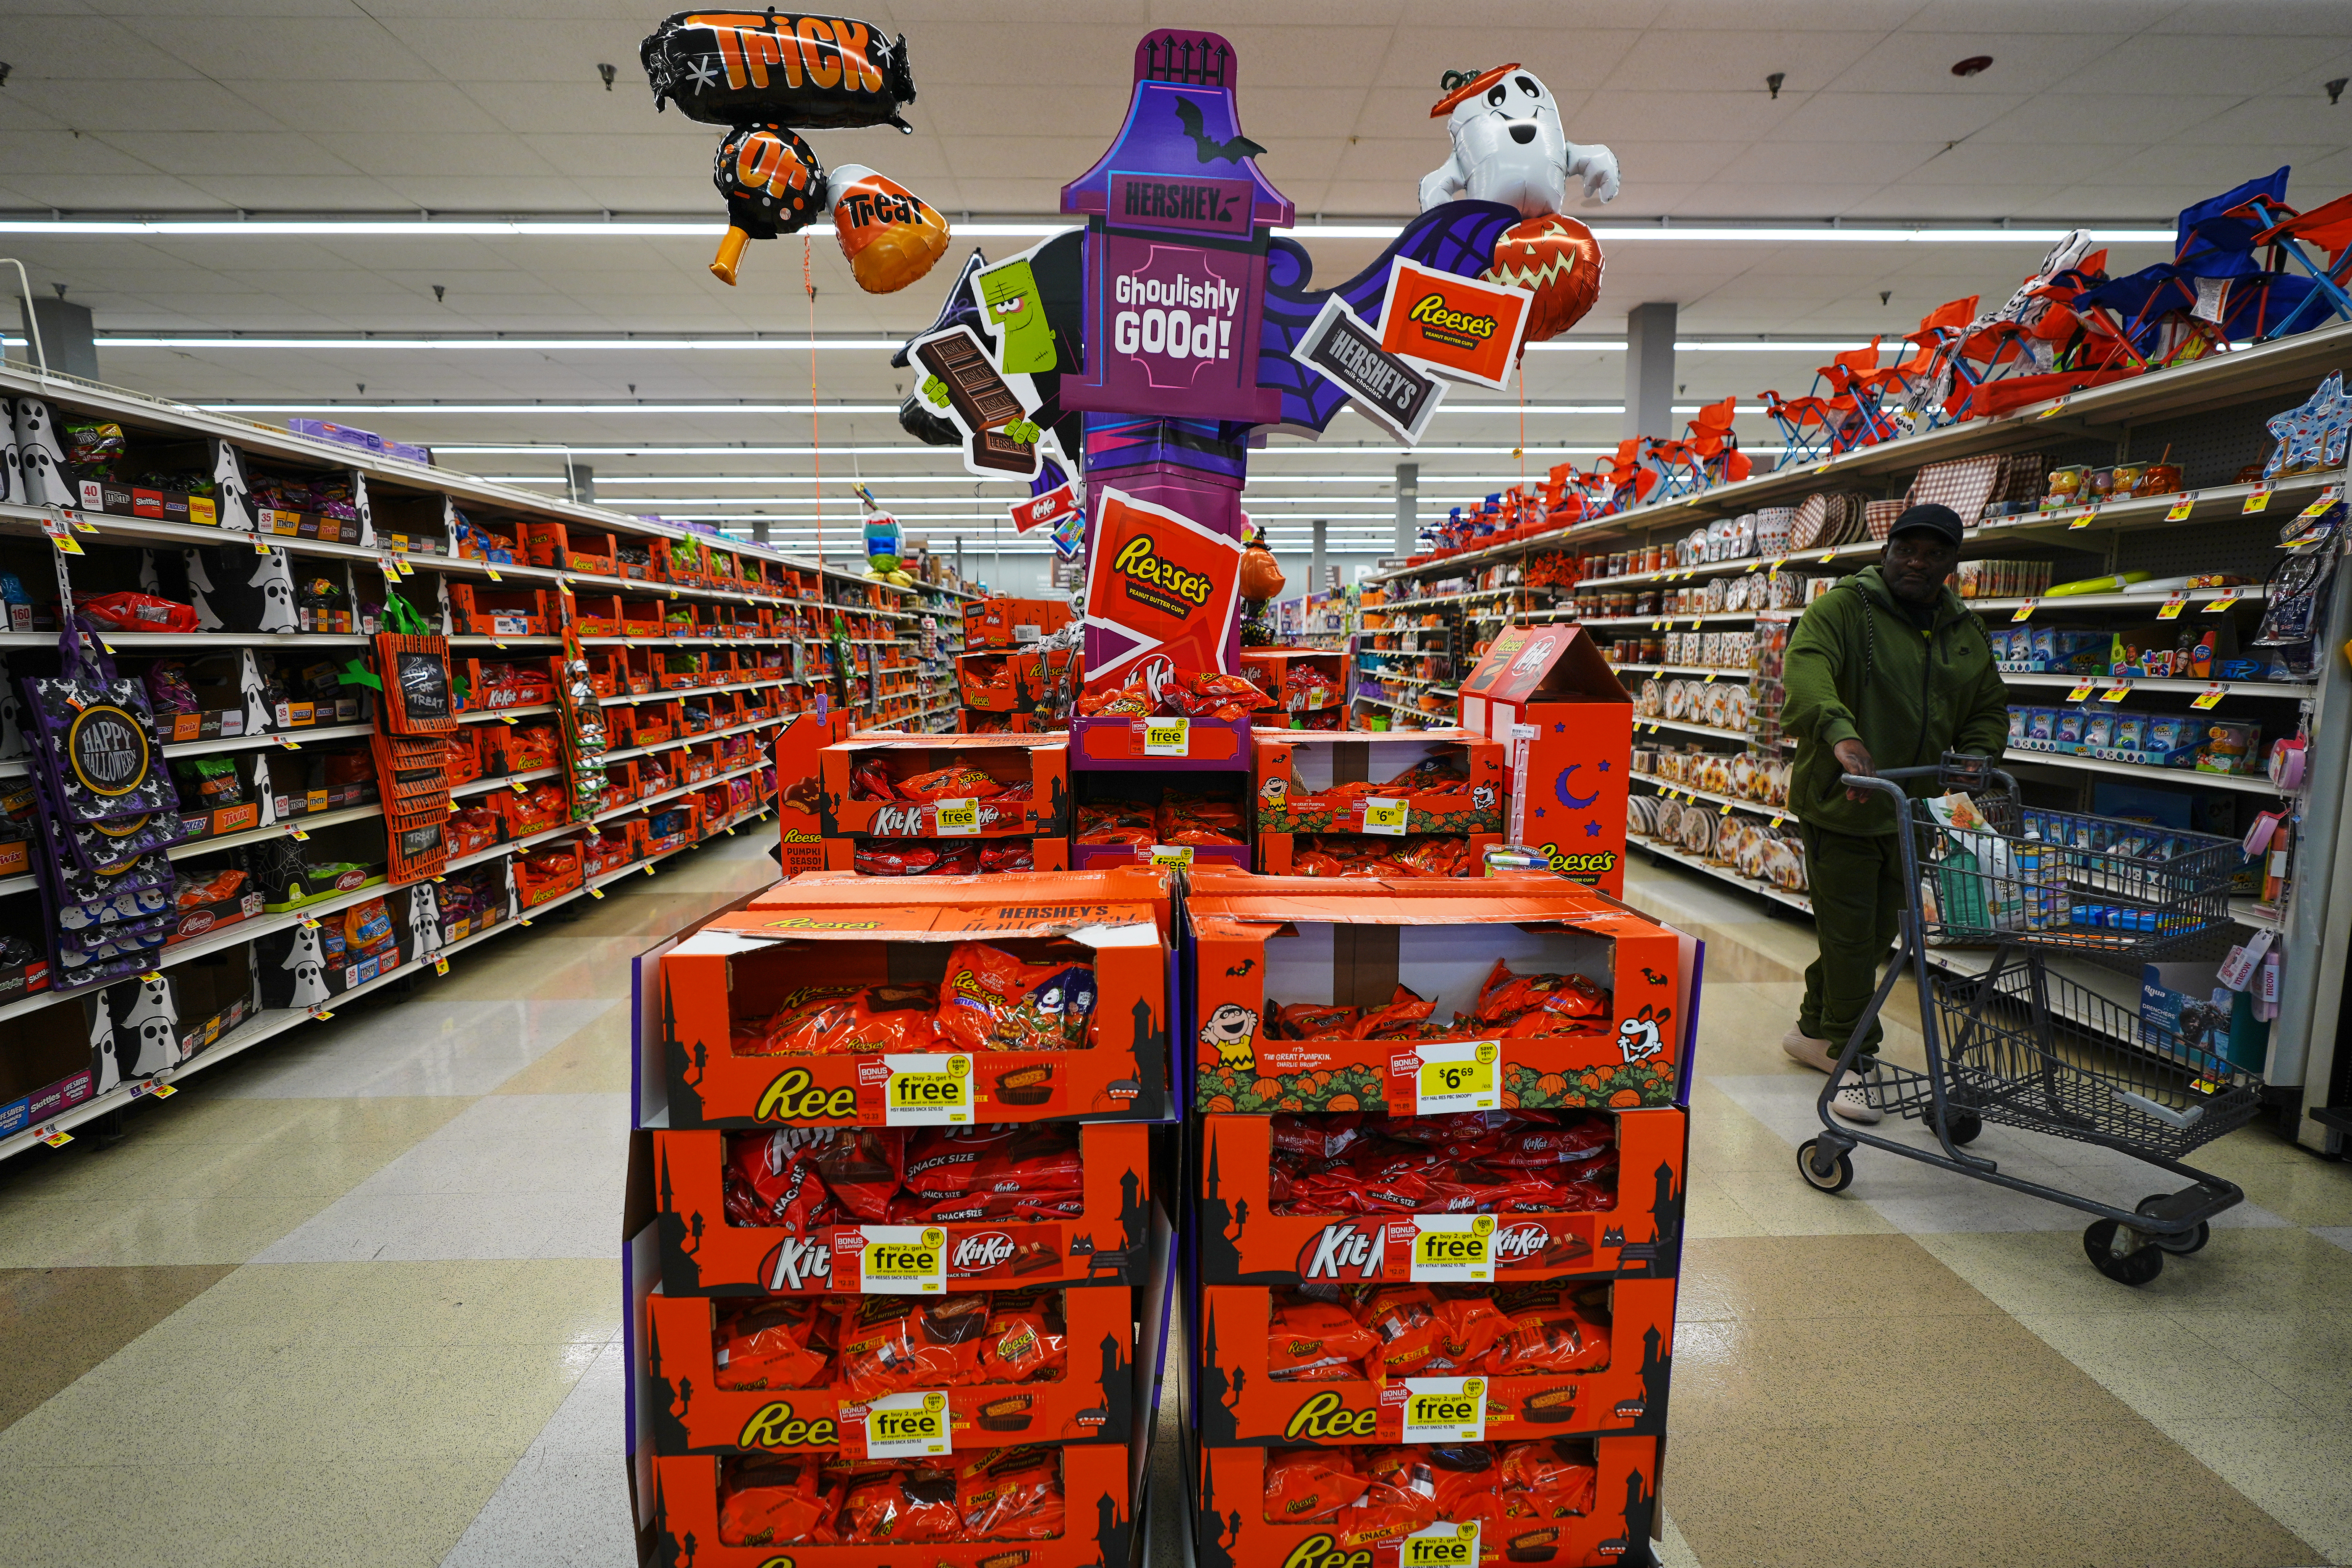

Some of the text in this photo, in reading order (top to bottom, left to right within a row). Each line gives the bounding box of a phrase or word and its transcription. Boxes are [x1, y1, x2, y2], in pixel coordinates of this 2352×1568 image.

[1116, 274, 1240, 316] Ghoulishly
[1410, 295, 1496, 338] Reese's
[1425, 331, 1443, 340] PEANUT
[1444, 335, 1461, 343] BUTTER
[936, 338, 973, 356] HERSHEY'S
[957, 366, 991, 386] HERSHEY'S
[1329, 330, 1417, 409] HERSHEY'S
[1344, 369, 1382, 399] milk chocolate
[979, 393, 1012, 412] HERSHEY'S
[84, 486, 97, 496] 40
[191, 503, 213, 512] Starburst
[1033, 498, 1056, 519] KitKat
[262, 513, 271, 522] 35
[572, 555, 594, 571] Reese's
[1116, 537, 1212, 604] Reese's
[1129, 588, 1185, 615] PEANUT BUTTER CUPS
[13, 609, 29, 620] 160
[579, 620, 598, 634] Reese's
[2147, 662, 2169, 677] TOYS
[412, 694, 444, 708] TREAT
[488, 688, 517, 707] KitKat
[970, 690, 990, 706] Reese's
[278, 708, 287, 717] 35
[293, 710, 310, 718] SNICKERS
[179, 722, 196, 734] Twix
[1151, 730, 1181, 741] free
[82, 721, 131, 753] HAPPY
[83, 749, 137, 780] HALLOWEEN
[517, 755, 543, 771] Reese's
[276, 798, 287, 807] 120
[223, 807, 249, 826] Twix
[942, 811, 972, 822] free
[408, 830, 436, 843] TREAT
[1522, 846, 1540, 857] MARKER!
[532, 886, 555, 903] Reese's
[999, 906, 1108, 919] HERSHEY'S
[763, 918, 884, 930] Reese's
[2234, 962, 2252, 985] meow
[951, 971, 1005, 1005] Reese's
[2145, 985, 2166, 997] Aqua
[2142, 1003, 2175, 1019] DRENCHERS
[1394, 1058, 1419, 1067] BONUS
[898, 1078, 959, 1100] free
[30, 1092, 61, 1113] Skittles
[1522, 1137, 1548, 1150] KitKat
[907, 1153, 974, 1177] SNACK SIZE
[1371, 1192, 1416, 1207] SNACK SIZE
[1448, 1197, 1475, 1210] KitKat
[954, 1236, 1015, 1267] KitKat
[1426, 1236, 1483, 1256] free
[1288, 1340, 1323, 1354] Reese's
[1416, 1399, 1472, 1419] free
[877, 1414, 935, 1434] free
[970, 1484, 1014, 1505] SNACK SIZE
[744, 1527, 774, 1545] Reese's
[1359, 1523, 1414, 1542] SNACK SIZE
[1412, 1541, 1467, 1560] free
